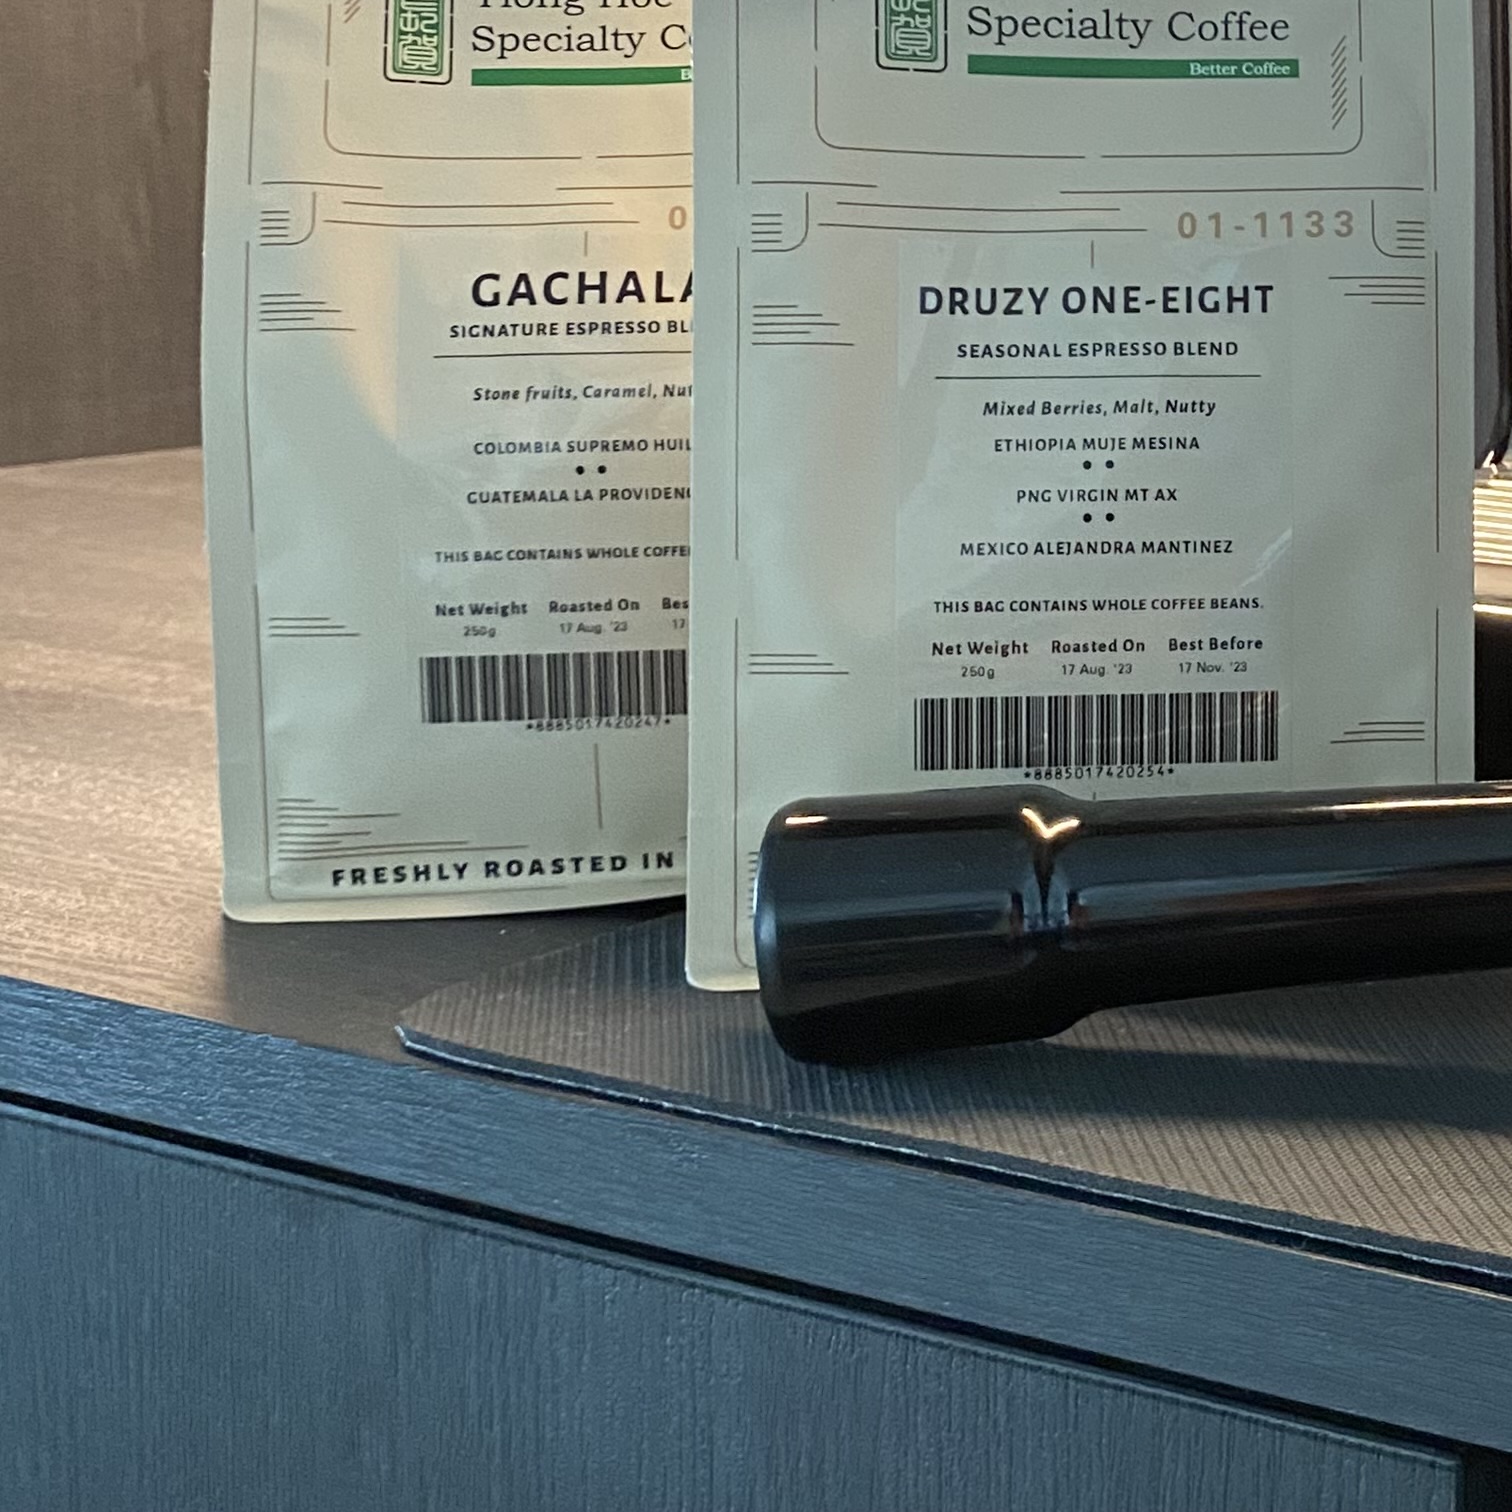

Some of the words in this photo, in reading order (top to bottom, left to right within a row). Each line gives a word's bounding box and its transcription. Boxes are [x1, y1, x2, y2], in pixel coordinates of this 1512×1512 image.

[967, 5, 1153, 49] Specialty
[1167, 10, 1290, 42] Coffee
[472, 25, 646, 59] Specialty
[1190, 62, 1239, 76] Better
[1243, 62, 1291, 76] Coffee
[1177, 210, 1356, 240] 01-1133
[919, 286, 1050, 316] DRUZY
[1062, 285, 1275, 315] ONE-EIGHT
[449, 322, 559, 338] SIGNATURE
[566, 320, 661, 336] ESPRESSO
[667, 319, 693, 334] BL
[956, 343, 1063, 359] SEASONAL
[1068, 342, 1168, 358] ESPRESSO
[1174, 341, 1240, 357] BLEND
[473, 386, 520, 401] Stone
[525, 385, 578, 403] fruits,
[582, 383, 658, 400] Caramel,
[982, 400, 1036, 417] Mixed
[1041, 400, 1108, 417] Berries,
[1113, 398, 1159, 416] Malt,
[1165, 399, 1217, 416] Nutty
[473, 441, 563, 456] COLOMBIA
[566, 439, 649, 454] SUPREMO
[994, 438, 1077, 453] ETHIOPIA
[1082, 437, 1127, 453] MUJE
[1132, 436, 1201, 451] MESINA
[467, 489, 570, 504] GUATEMALA
[574, 488, 594, 502] LA
[1016, 489, 1052, 503] PNG
[1058, 489, 1119, 503] VIRGIN
[1124, 488, 1149, 502] MT
[1154, 488, 1178, 502] AX
[435, 550, 469, 563] THIS
[474, 549, 503, 562] BAG
[507, 548, 583, 561] CONTAINS
[586, 546, 640, 559] WHOLE
[960, 541, 1029, 557] MEXICO
[1033, 540, 1137, 556] ALEJANDRA
[1140, 540, 1234, 555] MANTINEZ
[435, 603, 464, 616] Net
[469, 600, 528, 618] Weight
[549, 597, 613, 613] Roasted
[617, 598, 641, 612] On
[933, 600, 970, 614] THIS
[974, 600, 1005, 614] BAG
[1009, 599, 1088, 613] CONTAINS
[1092, 598, 1148, 612] WHOLE
[1151, 597, 1206, 611] COFFEE
[1210, 596, 1265, 610] BEANS.
[560, 622, 574, 634] 17
[932, 641, 963, 657] Net
[967, 638, 1030, 658] Weight
[1051, 638, 1119, 654] Roasted
[1122, 639, 1147, 653] On
[1168, 637, 1204, 652] Best
[1209, 636, 1264, 651] Before
[961, 665, 996, 679] 250g
[1062, 664, 1075, 676] 17
[1113, 662, 1133, 675] '23
[1178, 662, 1192, 675] 17
[1229, 660, 1248, 673] '23
[332, 861, 469, 887] FRESHLY
[484, 854, 627, 879] ROASTED
[642, 851, 675, 870] IN
